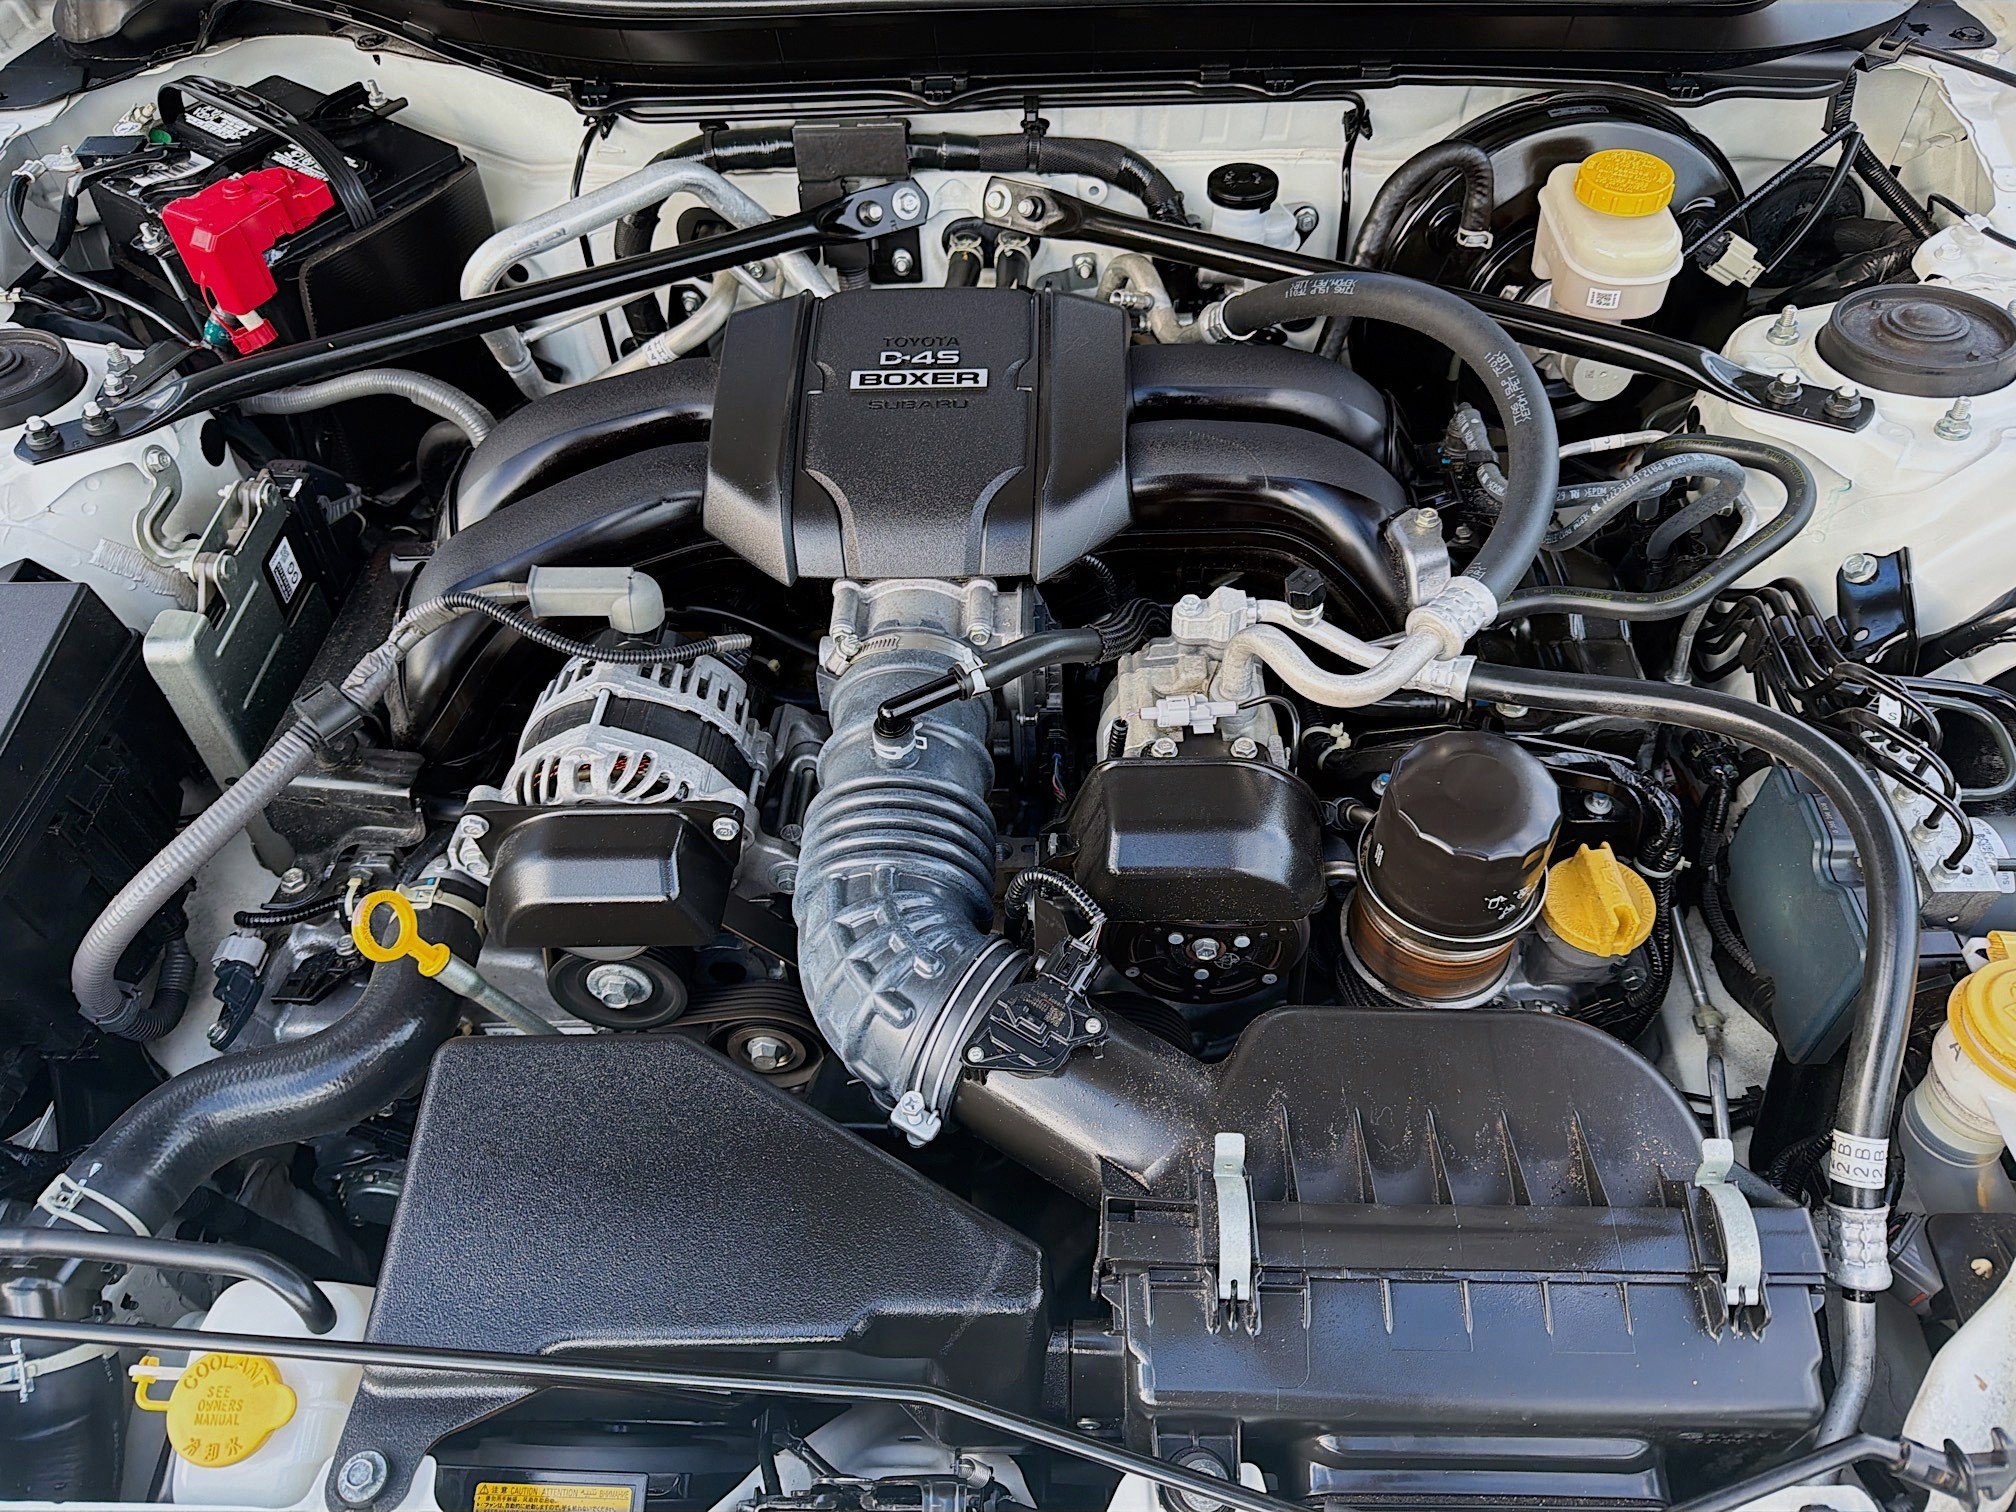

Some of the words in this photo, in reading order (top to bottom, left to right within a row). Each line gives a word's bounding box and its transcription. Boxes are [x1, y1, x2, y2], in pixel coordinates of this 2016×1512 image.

[882, 336, 959, 347] TOYOTA
[859, 372, 980, 386] BOXER
[868, 400, 969, 410] SUBARU
[184, 1354, 271, 1390] COOLANT
[207, 1386, 233, 1398] SEE
[194, 1413, 241, 1426] MANUAL
[510, 1486, 539, 1496] CAUTION
[542, 1488, 579, 1498] ATTENTION
